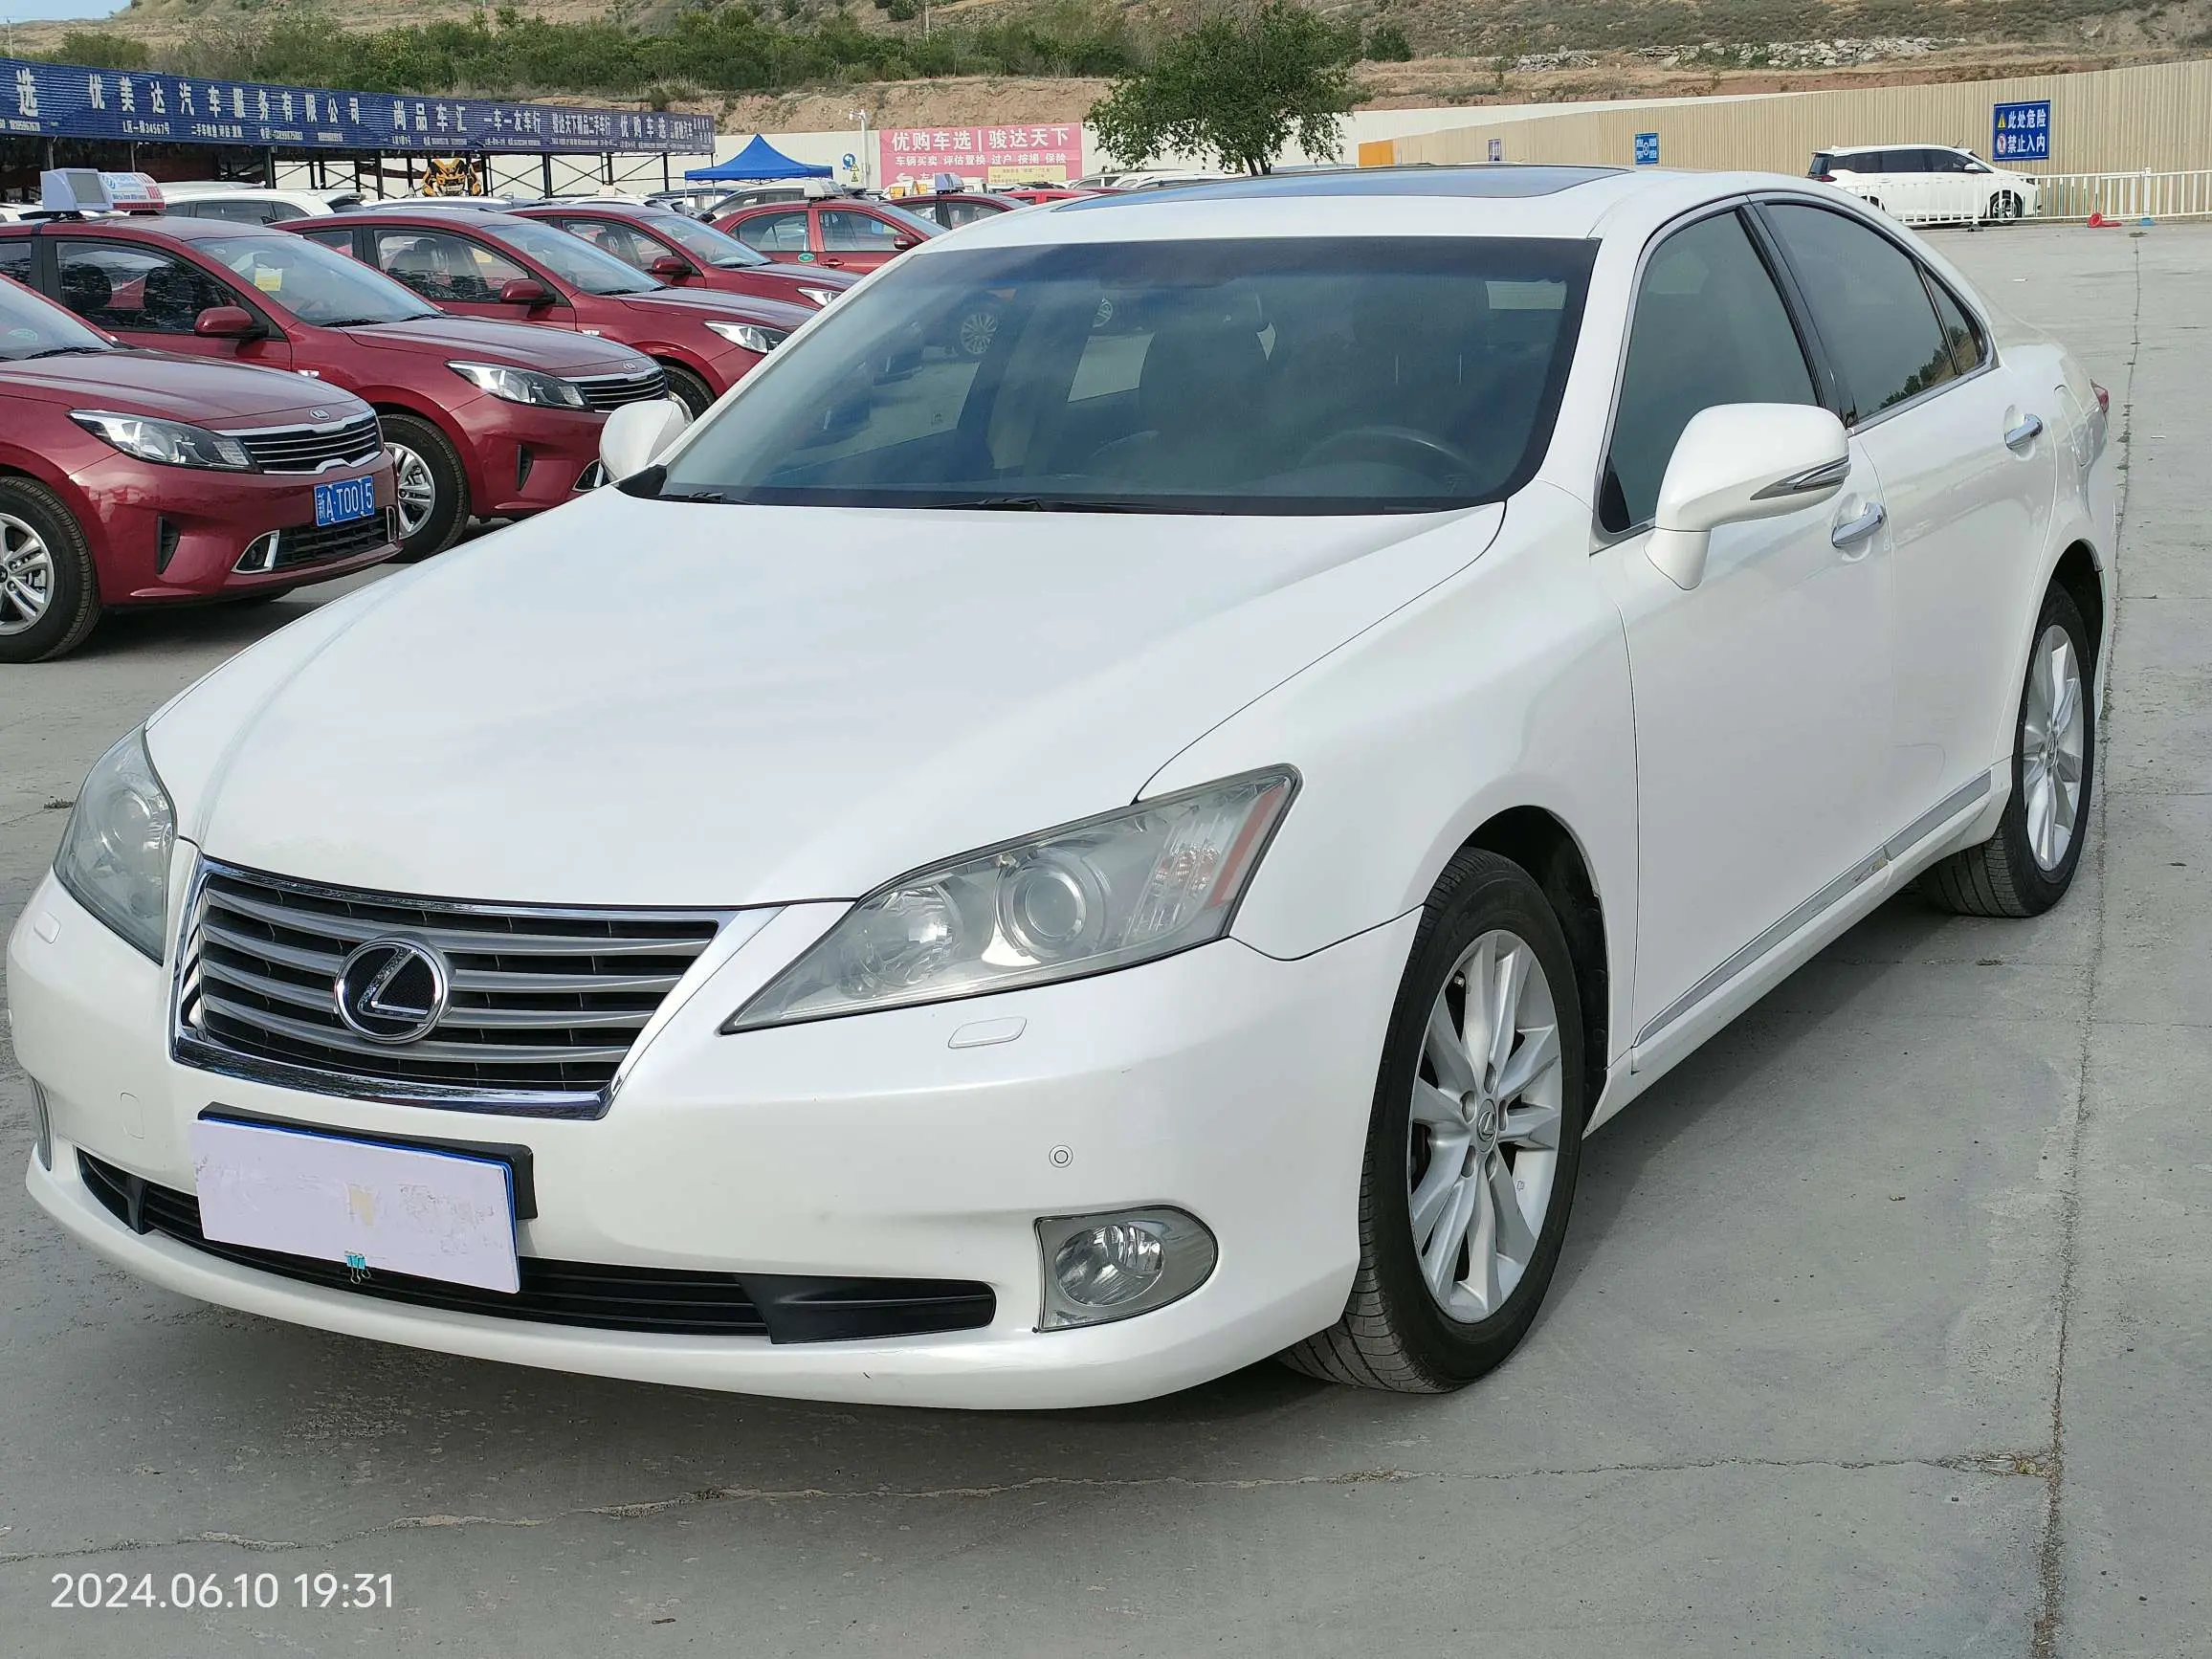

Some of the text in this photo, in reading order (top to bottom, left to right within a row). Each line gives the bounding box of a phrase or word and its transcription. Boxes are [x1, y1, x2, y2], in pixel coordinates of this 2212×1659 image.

[393, 100, 468, 133] 尚品车汇
[620, 114, 667, 140] 优购车选
[2007, 108, 2046, 129] 此处危险
[892, 127, 1070, 152] 优购车选 骏达天下
[2007, 132, 2046, 154] 禁止入内
[896, 155, 939, 166] 车辆买卖
[943, 154, 986, 166] 评估置换
[991, 153, 1013, 166] 过户
[1046, 152, 1067, 164] 保险
